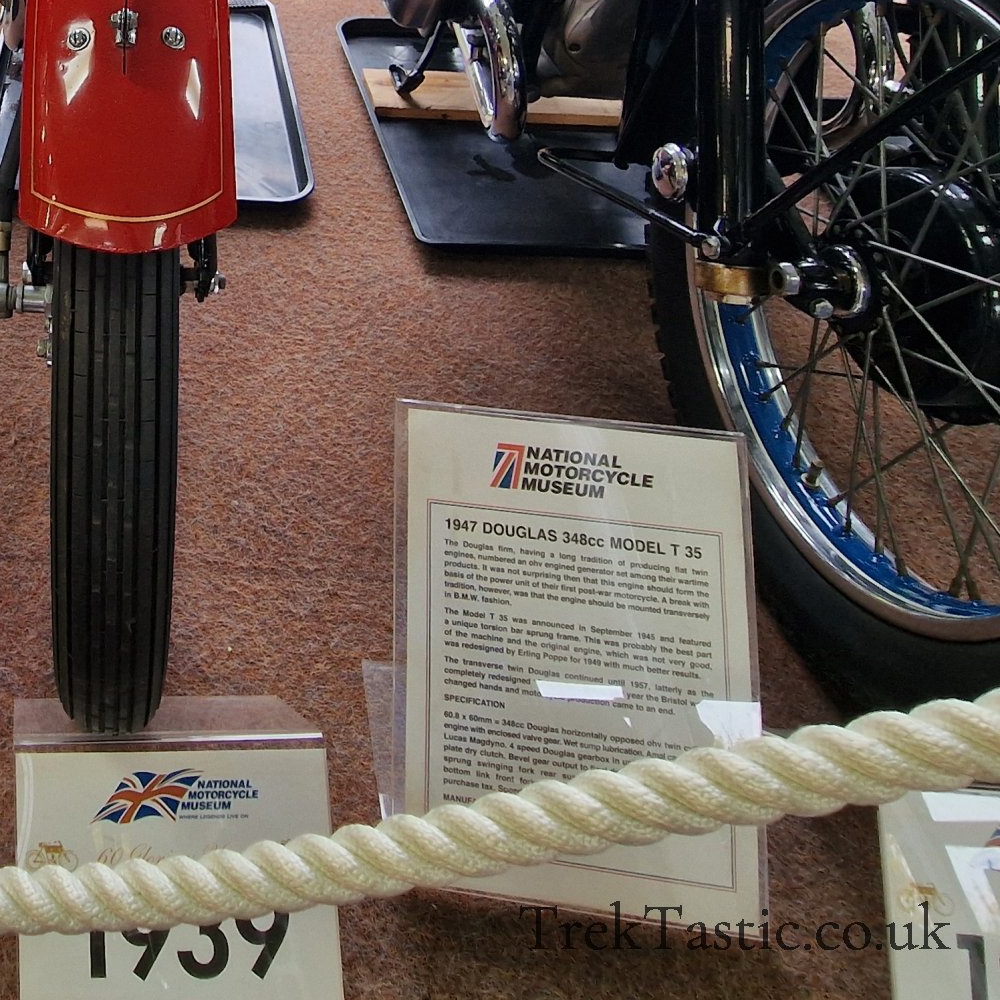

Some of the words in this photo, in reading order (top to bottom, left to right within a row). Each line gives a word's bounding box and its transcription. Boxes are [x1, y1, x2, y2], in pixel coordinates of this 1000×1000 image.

[523, 461, 654, 488] MOTORCYCLE
[526, 446, 622, 469] NATIONAL
[521, 477, 605, 499] MUSEUM
[444, 516, 477, 533] 1947
[482, 520, 557, 543] DOUGLAS
[562, 530, 604, 548] 348cc
[610, 535, 666, 555] MODEL
[669, 543, 680, 556] T
[684, 545, 702, 560] 35
[443, 537, 459, 547] The
[462, 539, 494, 553] Douglas
[519, 547, 545, 559] having
[558, 551, 576, 562] long
[580, 554, 613, 565] tradition
[617, 558, 625, 567] of
[629, 560, 670, 574] producing
[674, 565, 687, 574] flat
[691, 568, 708, 576] twin
[477, 552, 516, 564] numbered
[528, 559, 542, 567] ohv
[544, 560, 575, 573] engined
[576, 564, 614, 578] generator
[615, 569, 628, 578] set
[629, 572, 657, 582] among
[657, 574, 676, 583] their
[677, 577, 709, 587] wartime
[443, 569, 464, 579] basis
[465, 571, 474, 580] of
[475, 573, 488, 582] the
[489, 576, 513, 586] power
[514, 578, 530, 587] unit
[531, 580, 539, 588] of
[541, 581, 559, 590] their
[560, 583, 576, 593] first
[577, 586, 612, 598] post-war
[661, 596, 667, 604] A
[668, 597, 691, 607] break
[692, 599, 709, 609] with
[481, 563, 487, 571] It
[489, 565, 505, 573] was
[507, 567, 520, 575] not
[521, 569, 561, 582] surprising
[563, 573, 581, 583] then
[582, 576, 598, 585] that
[600, 578, 615, 587] this
[617, 581, 644, 592] engine
[646, 583, 673, 594] should
[675, 587, 694, 596] form
[696, 590, 709, 598] the
[443, 606, 459, 615] The
[462, 608, 485, 619] Model
[489, 612, 494, 620] T
[498, 613, 508, 622] 35
[511, 616, 528, 625] was
[531, 618, 575, 631] announced
[578, 623, 586, 632] in
[590, 624, 632, 639] September
[637, 631, 655, 641] 1945
[659, 634, 674, 643] and
[678, 636, 711, 648] featured
[451, 618, 478, 630] unique
[480, 622, 508, 633] torsion
[510, 626, 523, 635] bar
[525, 629, 554, 640] sprung
[583, 635, 601, 645] This
[603, 639, 619, 647] was
[622, 640, 657, 653] probably
[659, 645, 673, 654] the
[675, 647, 693, 656] best
[696, 650, 712, 660] part
[443, 627, 452, 636] of
[454, 629, 468, 638] the
[470, 631, 504, 643] machine
[506, 636, 521, 645] and
[524, 638, 537, 647] the
[540, 640, 570, 653] original
[605, 649, 629, 659] which
[632, 653, 648, 662] was
[651, 655, 665, 664] not
[668, 658, 685, 668] very
[443, 639, 459, 648] was
[461, 641, 504, 656] redesigned
[505, 647, 515, 657] by
[517, 648, 541, 660] Erling
[542, 651, 568, 663] Poppe
[569, 655, 581, 664] for
[583, 657, 601, 667] 1949
[603, 660, 620, 669] with
[622, 662, 644, 672] much
[646, 665, 670, 676] better
[443, 692, 505, 709] SPECIFICATION
[188, 790, 259, 800] MOTORCYCLE
[197, 779, 252, 789] NATIONAL
[181, 800, 231, 810] MUSEUM
